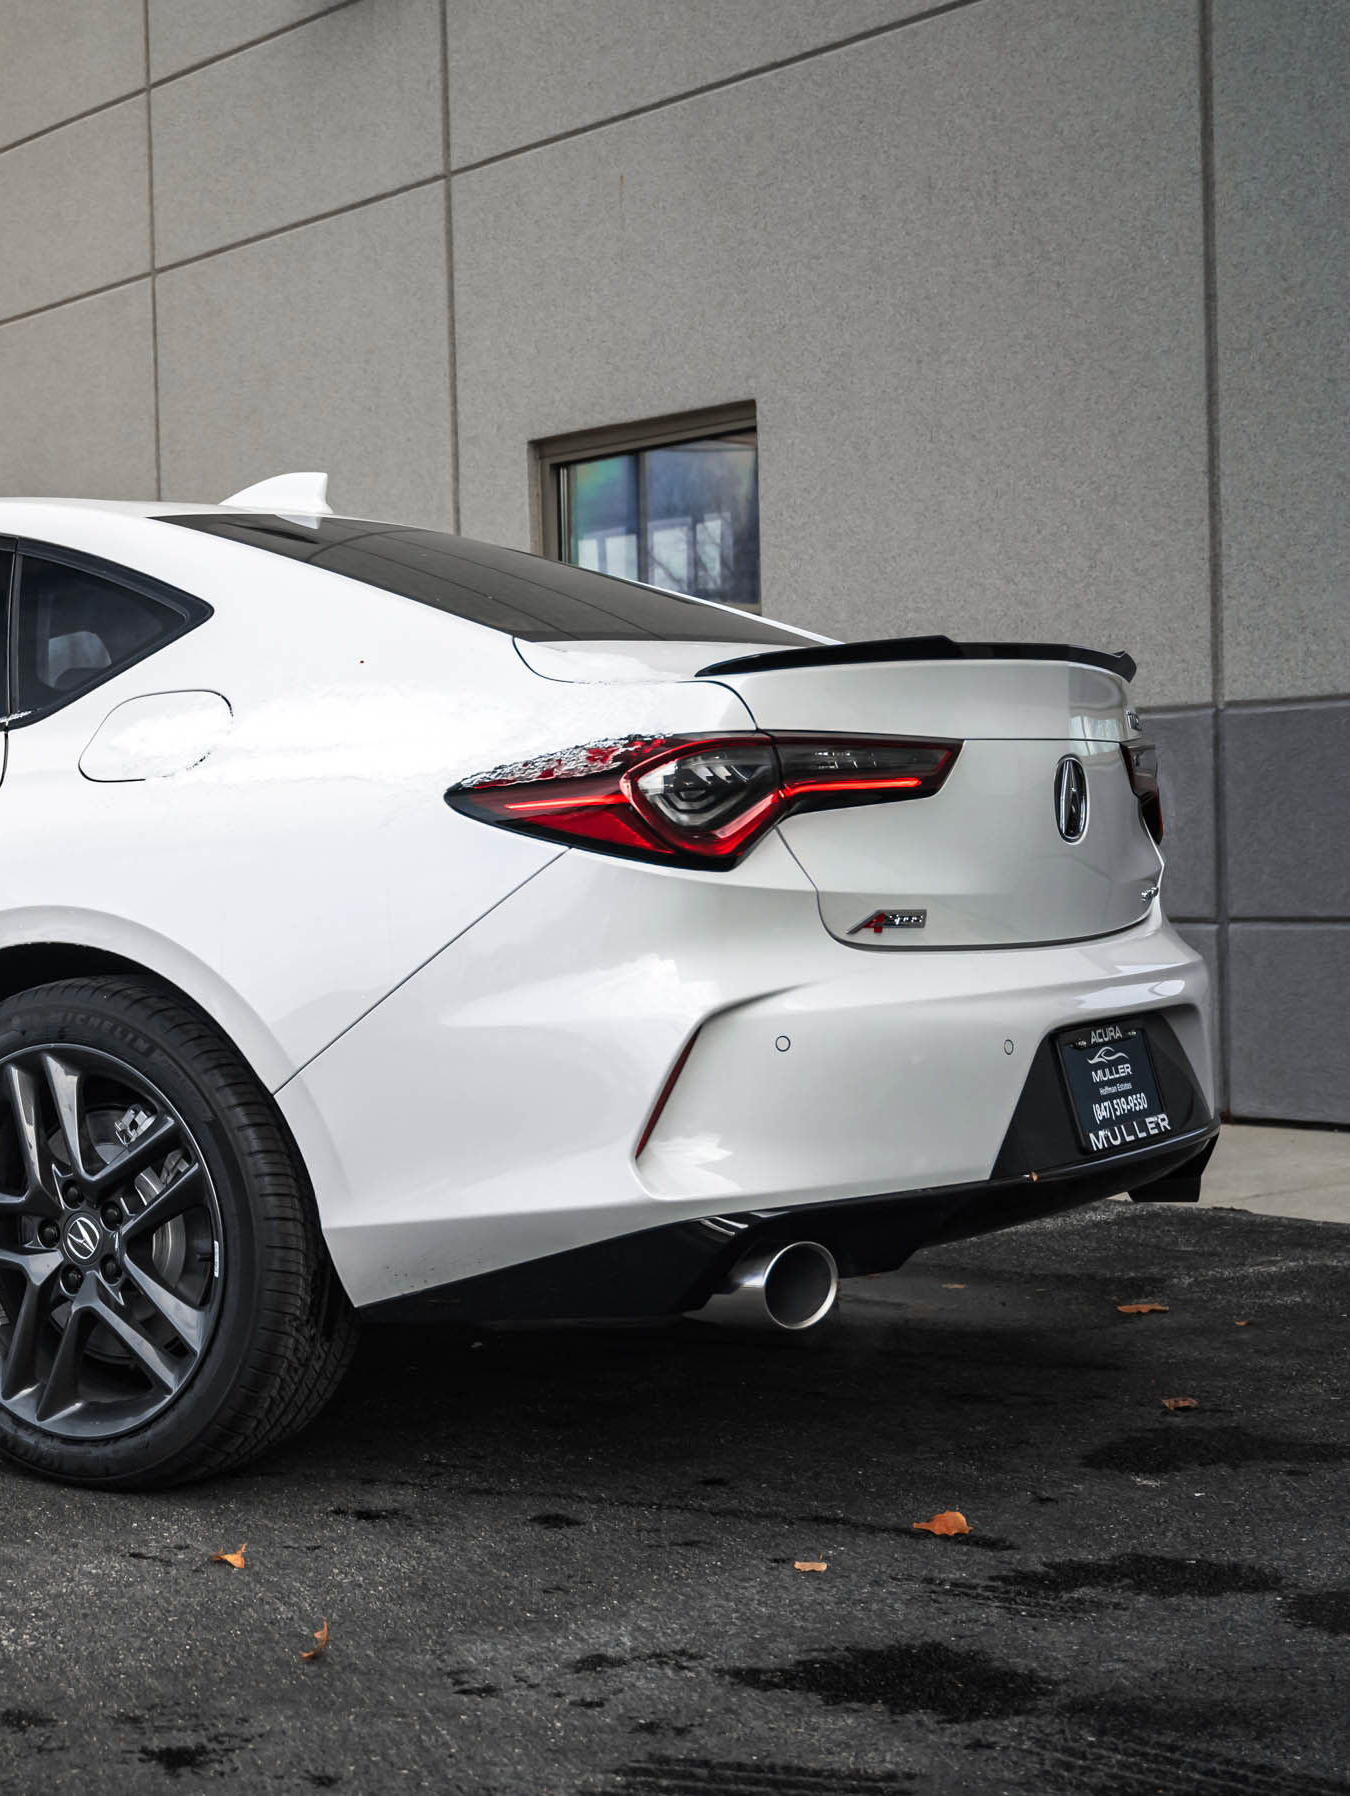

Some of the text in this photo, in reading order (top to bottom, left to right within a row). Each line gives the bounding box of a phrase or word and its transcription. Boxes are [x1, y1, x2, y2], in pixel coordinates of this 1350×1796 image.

[1090, 1026, 1123, 1044] ACURA
[1091, 1064, 1132, 1083] MULLER
[1092, 1092, 1148, 1125] (847) 519-9550
[1089, 1113, 1171, 1151] MULLER
